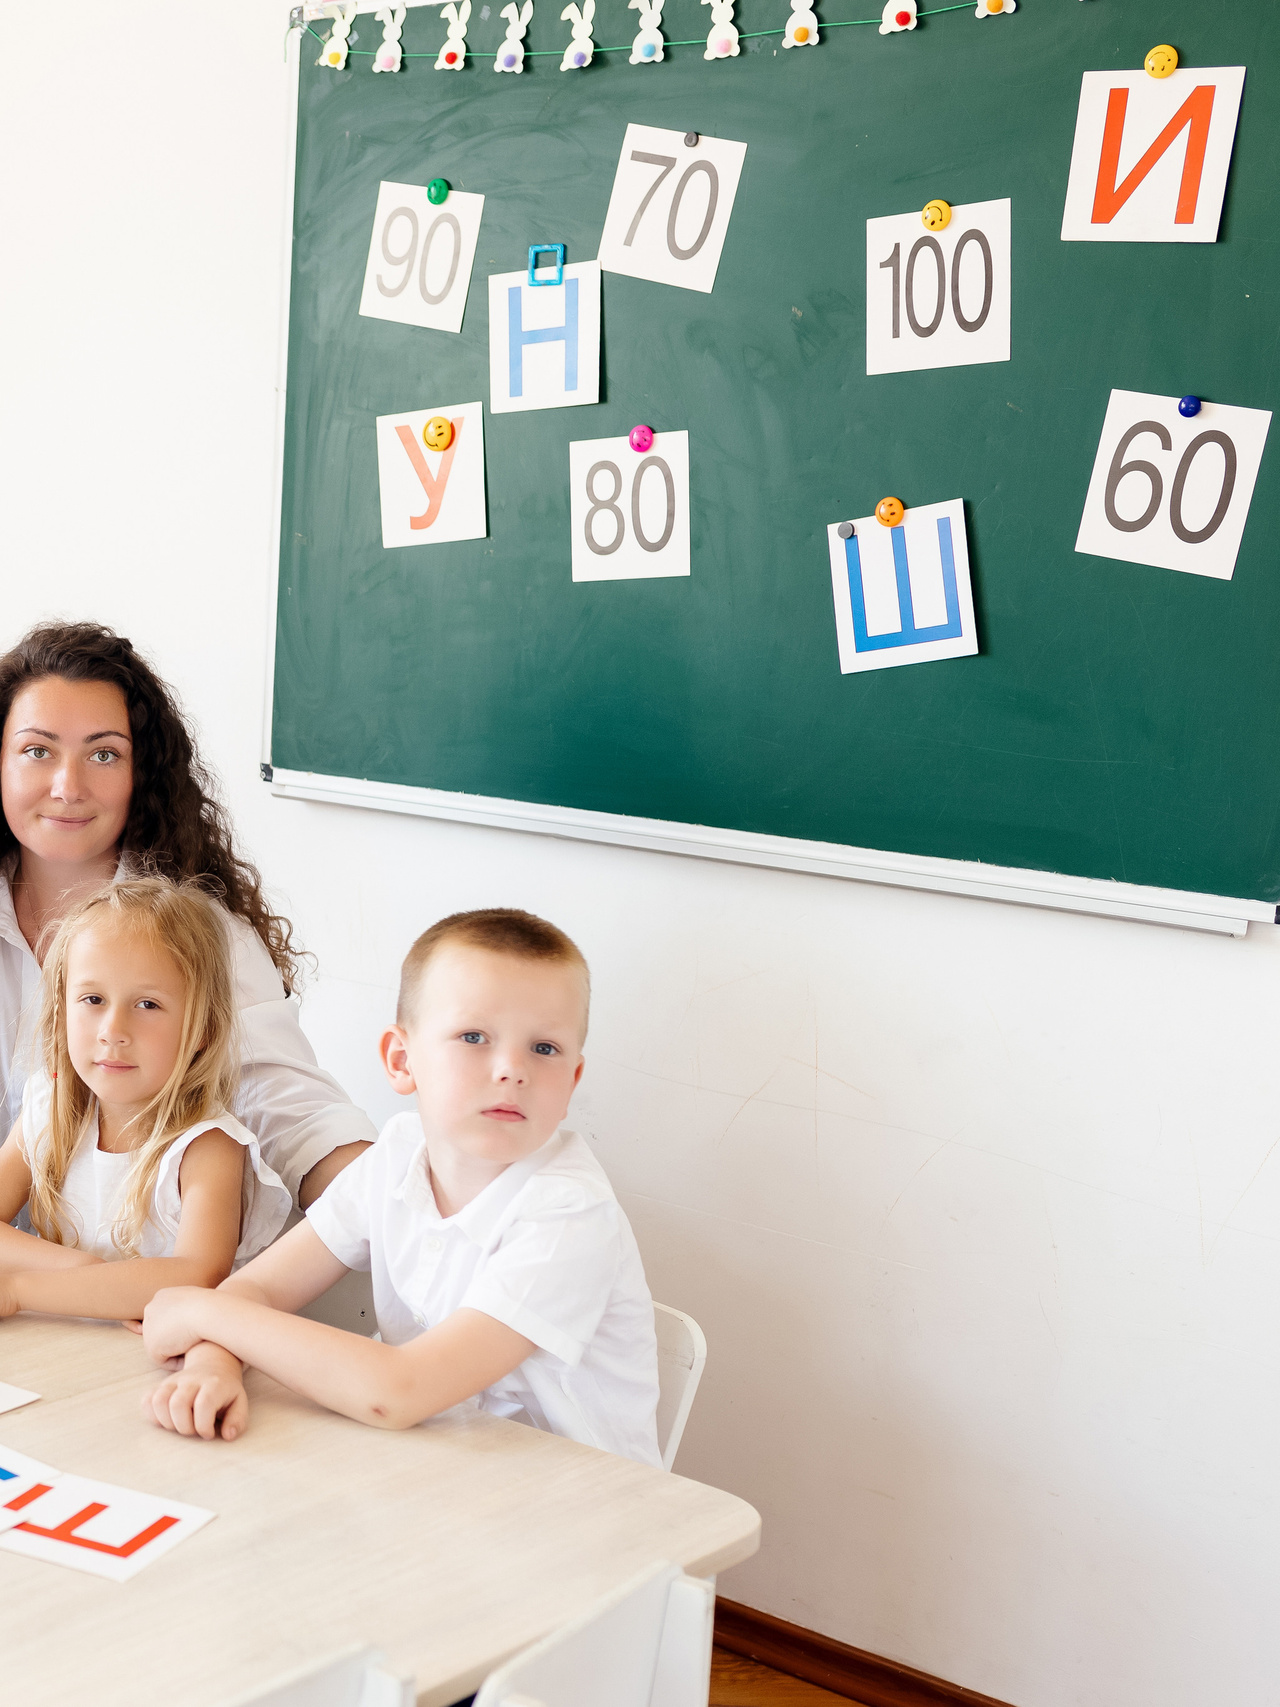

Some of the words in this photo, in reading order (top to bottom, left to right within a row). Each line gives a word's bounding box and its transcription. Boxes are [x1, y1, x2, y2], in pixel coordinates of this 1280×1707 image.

[623, 150, 719, 260] 70
[1091, 85, 1216, 224] И
[377, 207, 461, 305] 90
[879, 229, 993, 339] 100
[584, 456, 675, 556] 80
[1104, 420, 1237, 544] 60
[845, 517, 962, 653] Ш
